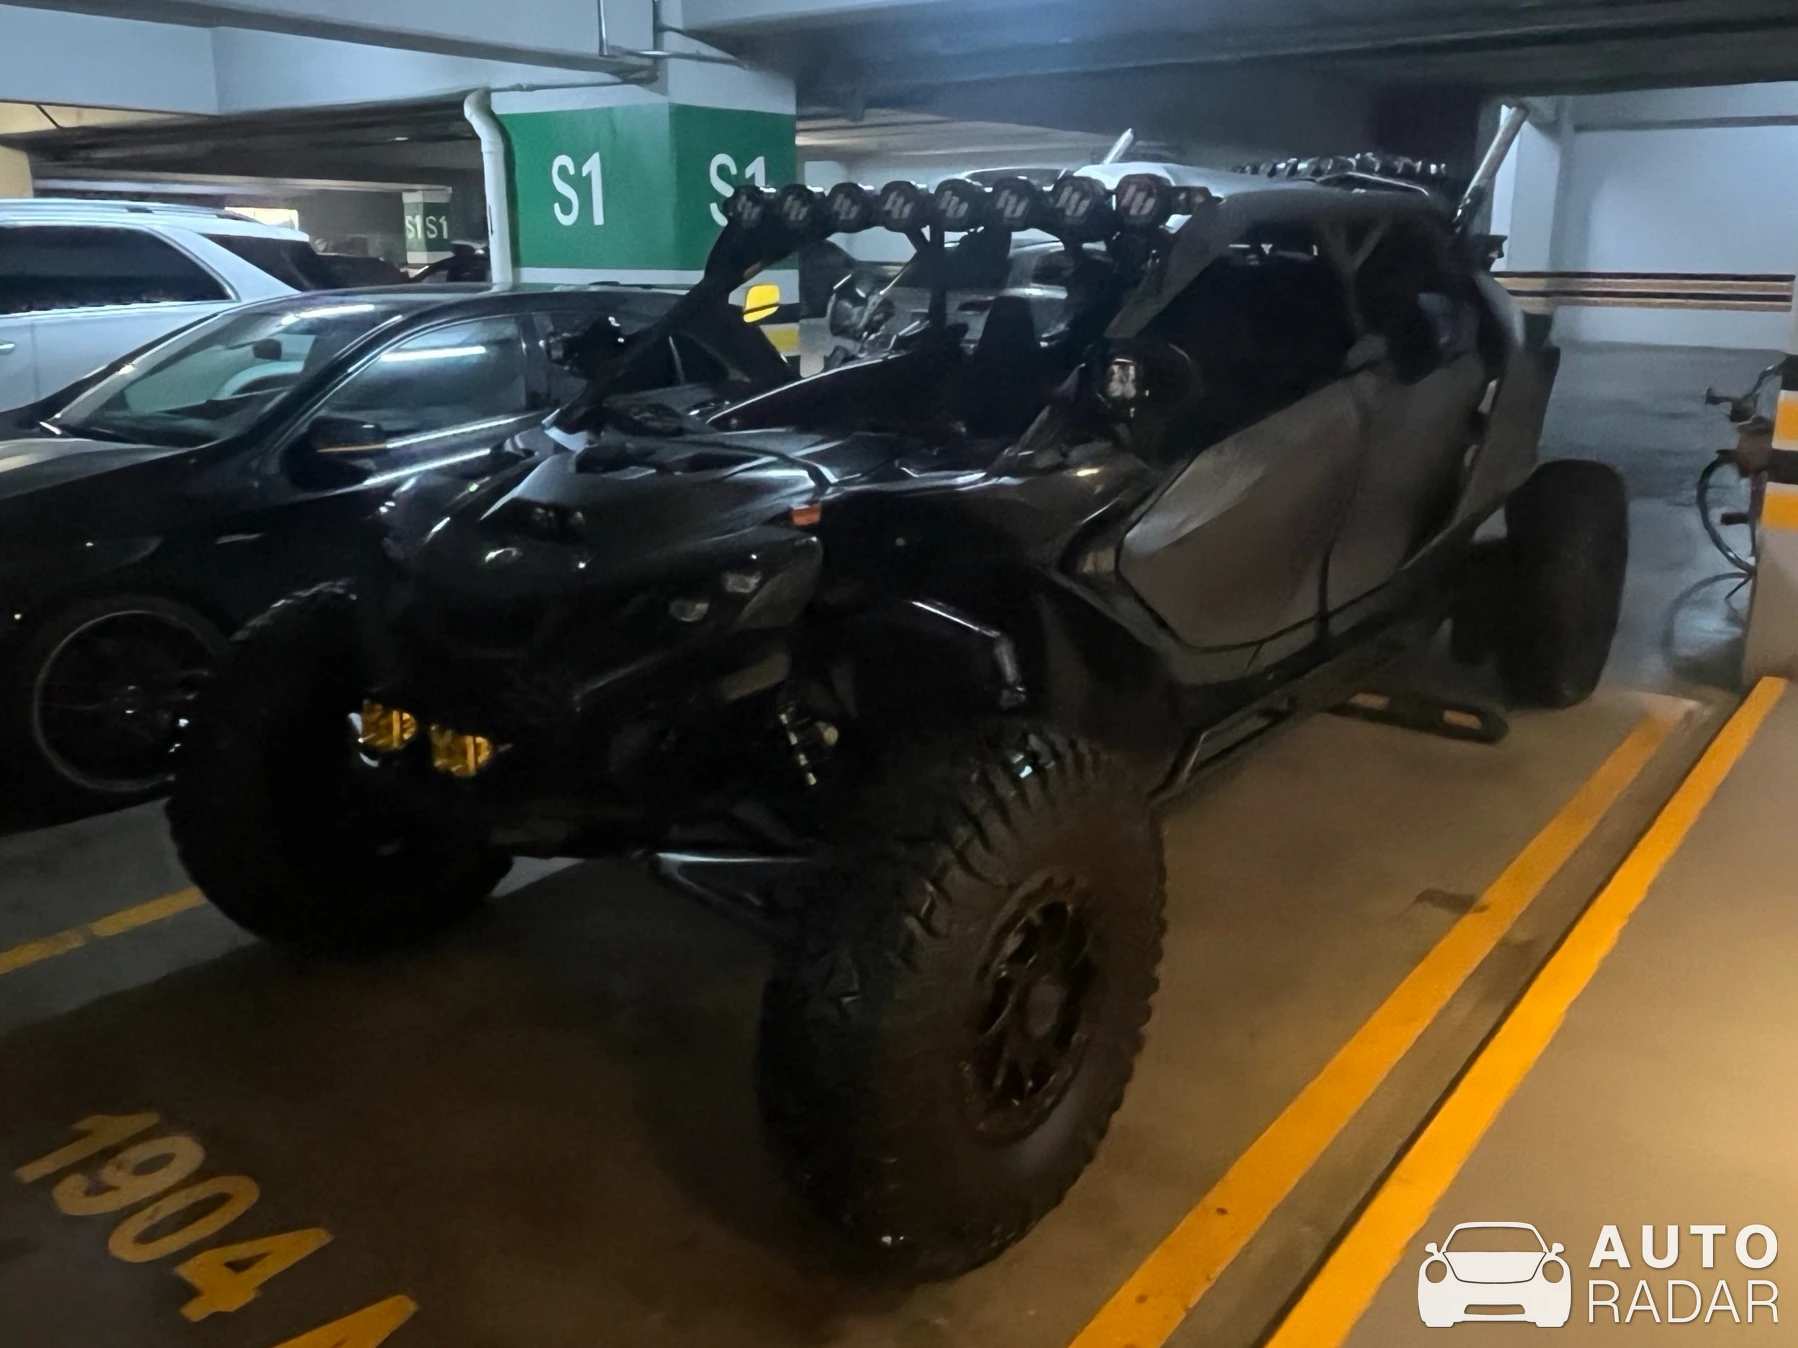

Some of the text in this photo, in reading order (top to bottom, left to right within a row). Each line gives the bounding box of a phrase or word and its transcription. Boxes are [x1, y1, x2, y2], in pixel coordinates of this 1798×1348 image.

[551, 152, 604, 226] S1
[405, 214, 422, 239] S1
[425, 215, 449, 239] S1
[12, 1111, 334, 1322] 1904
